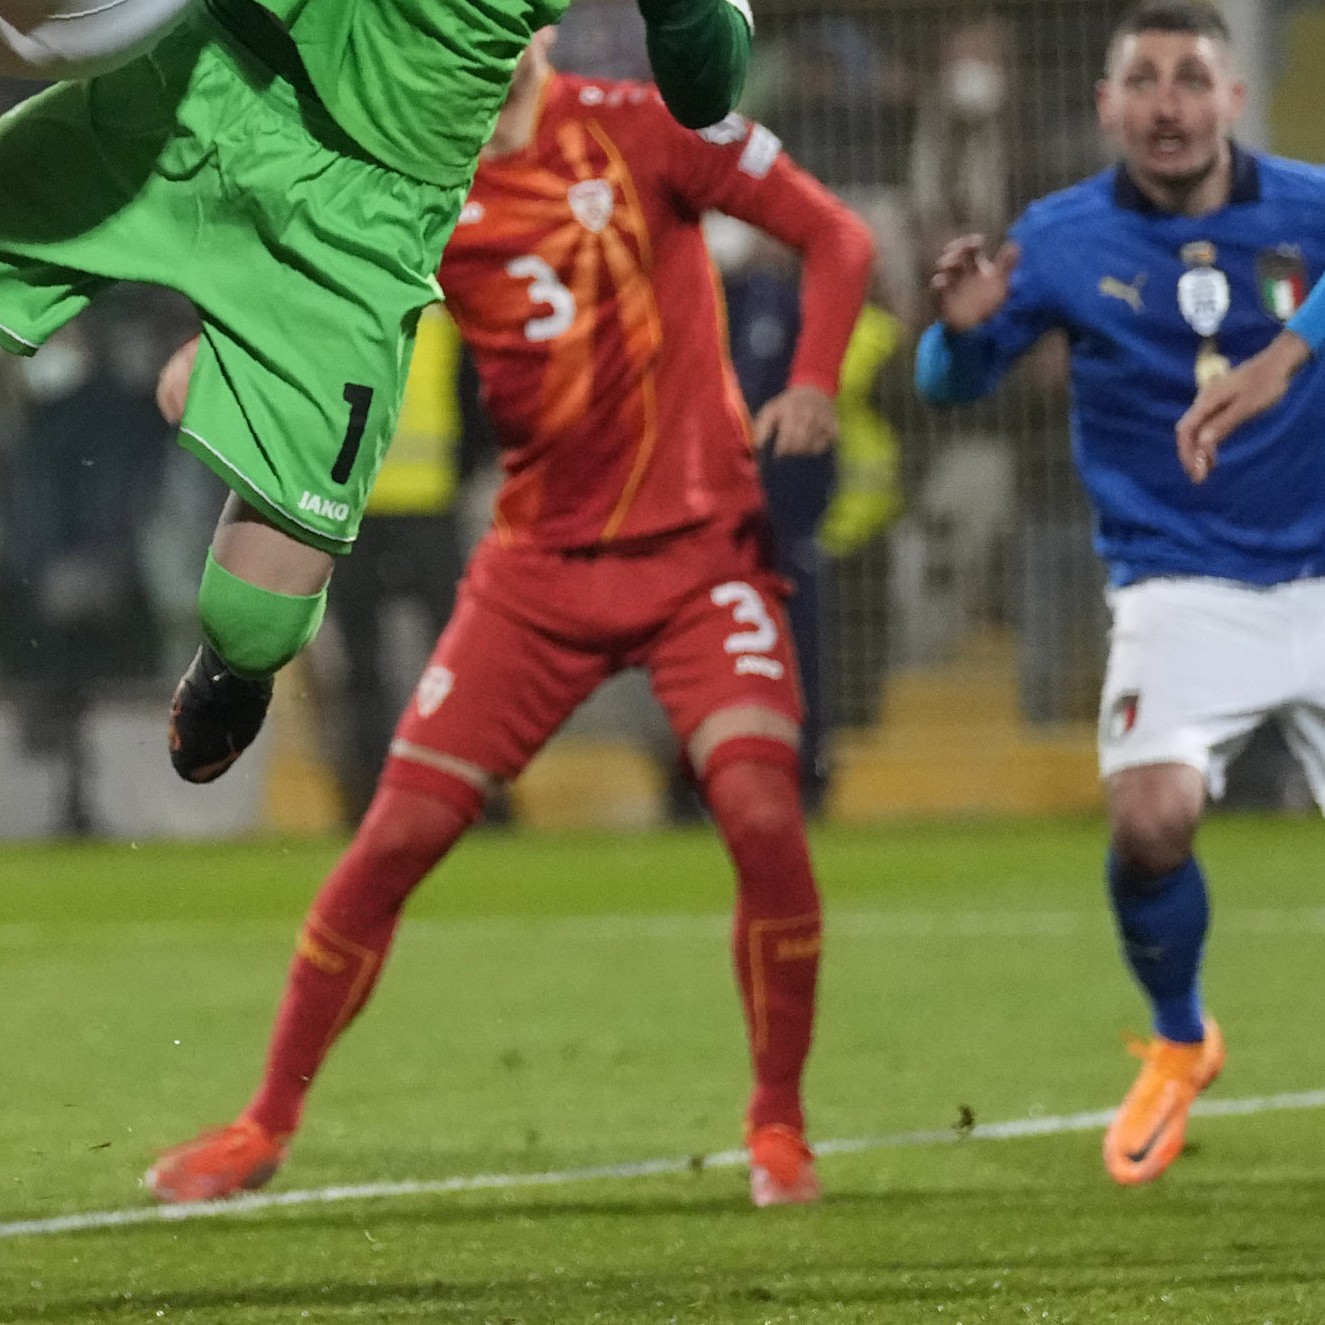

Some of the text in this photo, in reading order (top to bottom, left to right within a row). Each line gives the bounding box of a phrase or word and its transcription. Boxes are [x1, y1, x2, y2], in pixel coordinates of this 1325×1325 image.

[507, 254, 576, 342] 3
[330, 382, 373, 484] 1
[298, 490, 349, 522] JAKO
[710, 580, 779, 655] 3
